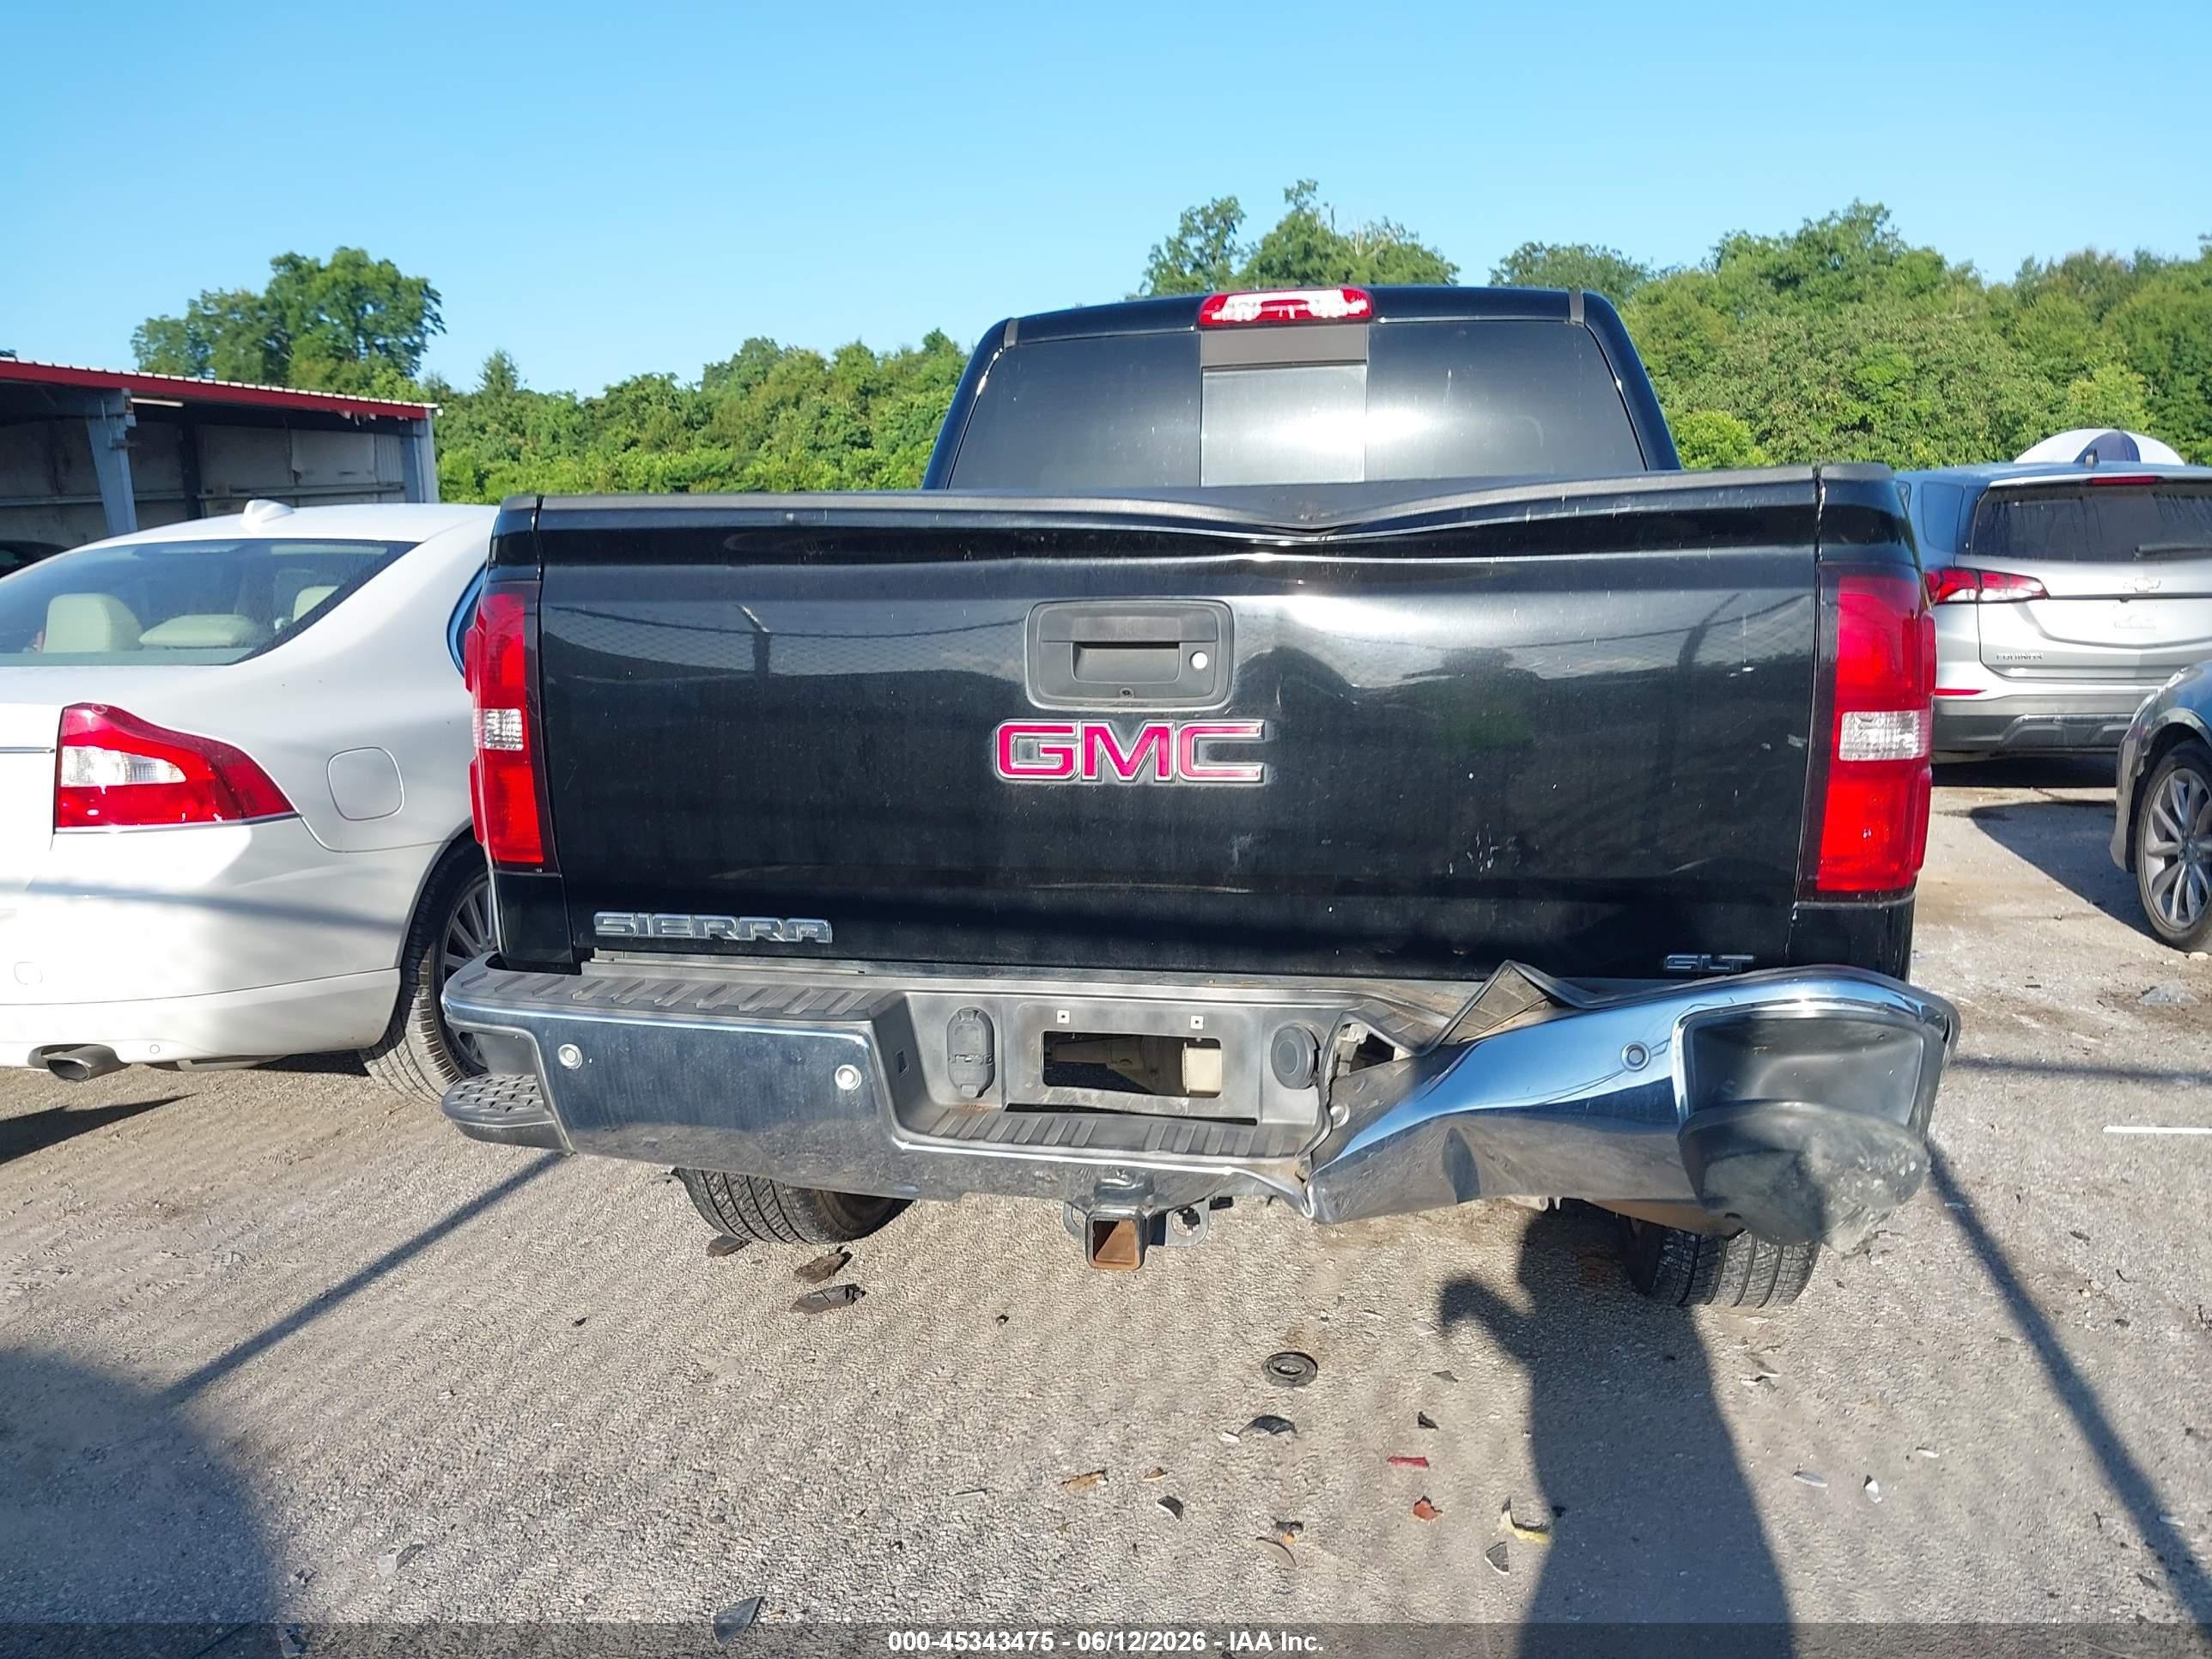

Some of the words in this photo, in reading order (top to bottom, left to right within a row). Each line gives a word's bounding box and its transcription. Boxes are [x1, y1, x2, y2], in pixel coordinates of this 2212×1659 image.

[995, 719, 1265, 784] GMC
[593, 911, 834, 943] SIERRA
[1663, 954, 1754, 973] SLT
